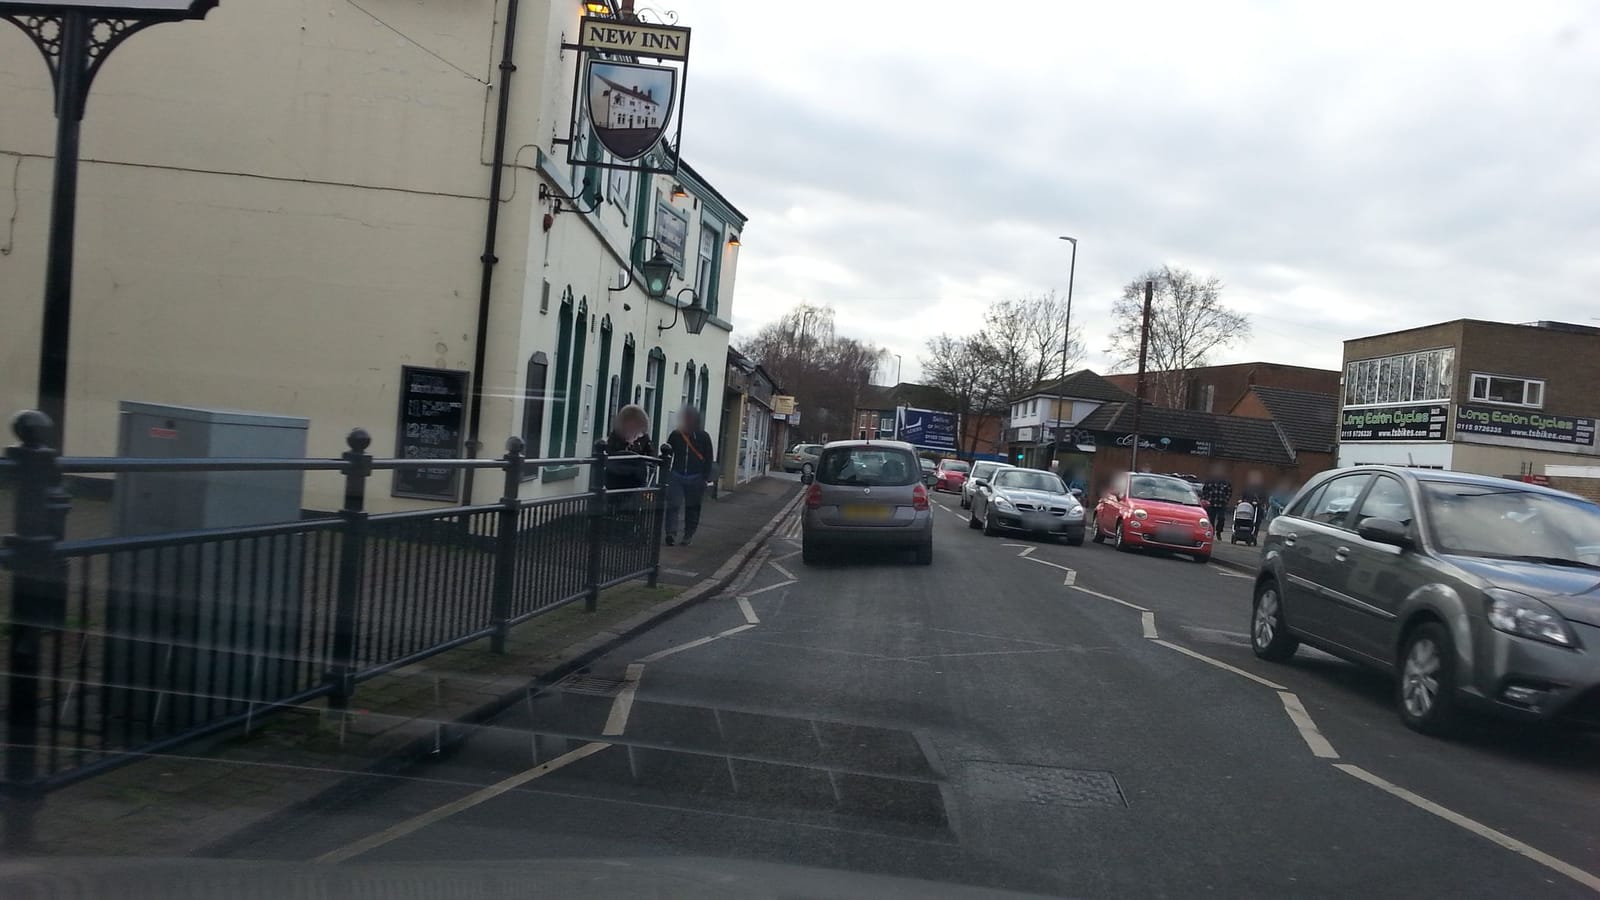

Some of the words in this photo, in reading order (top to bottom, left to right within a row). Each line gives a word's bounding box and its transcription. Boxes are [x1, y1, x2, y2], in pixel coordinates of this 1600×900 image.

[590, 27, 637, 46] NEW
[640, 32, 681, 51] INN
[1343, 413, 1365, 428] Long
[1365, 412, 1392, 425] Eaton
[1393, 410, 1429, 427] Cycles
[1459, 407, 1489, 424] Long
[1491, 411, 1528, 425] Eaton
[1530, 415, 1573, 430] Cycles
[1378, 428, 1427, 437] www.tsbikes.com
[1456, 423, 1472, 431] 0115
[1511, 428, 1572, 441] www.tsbikes.com
